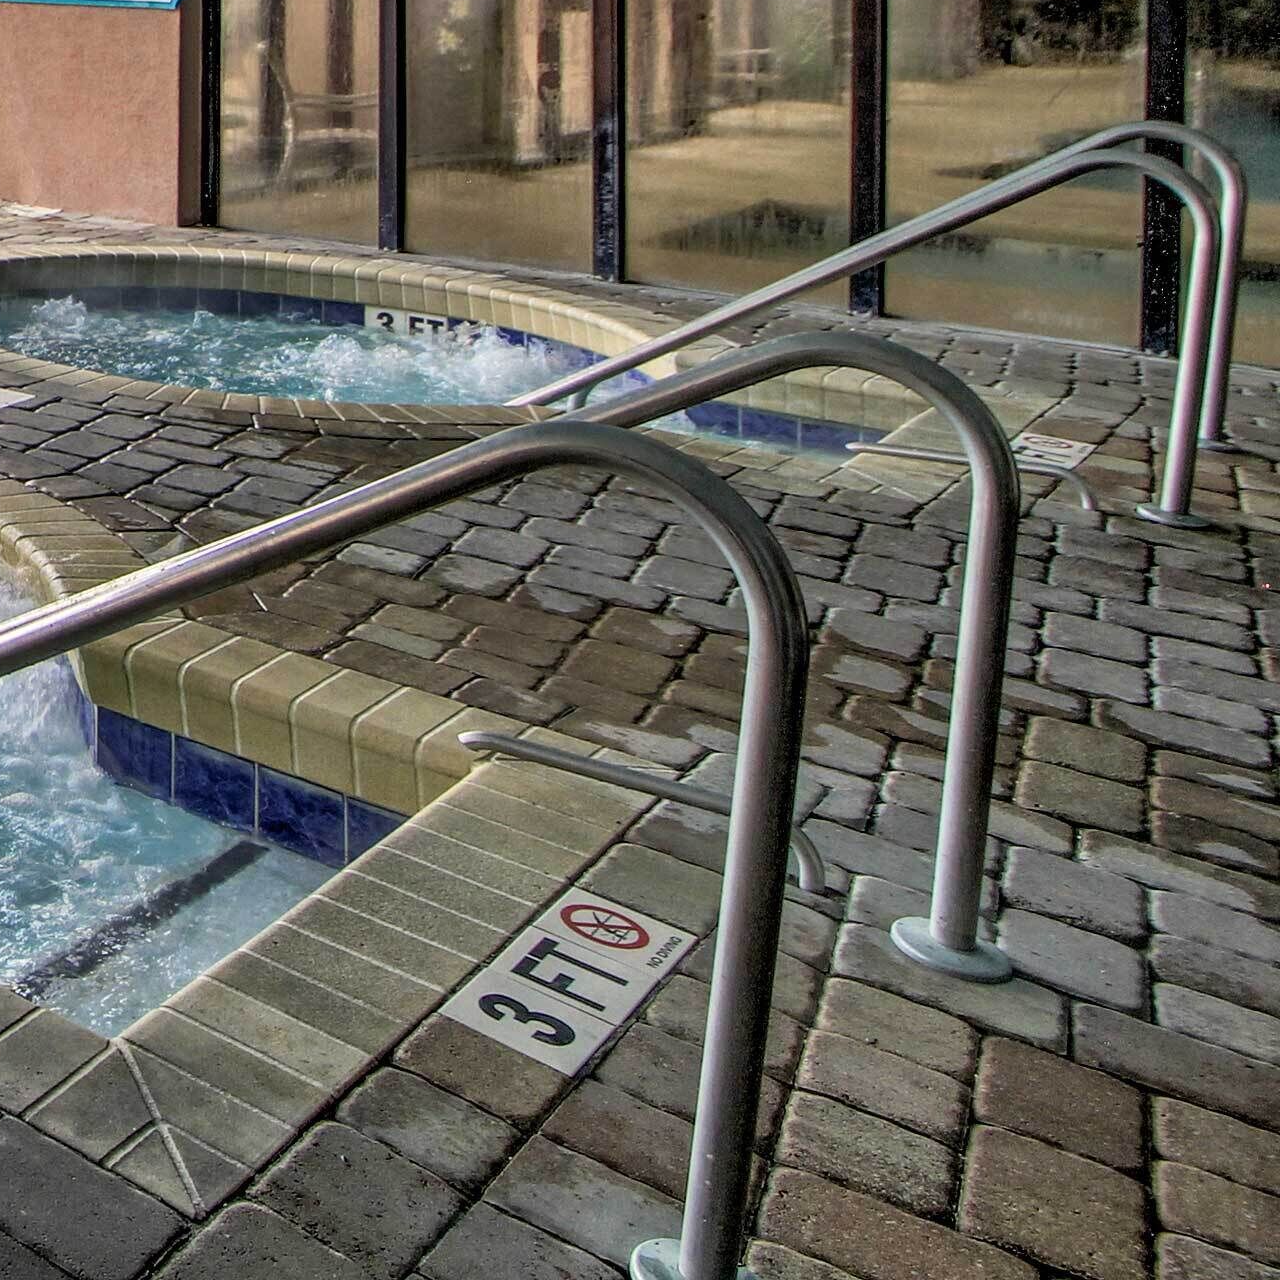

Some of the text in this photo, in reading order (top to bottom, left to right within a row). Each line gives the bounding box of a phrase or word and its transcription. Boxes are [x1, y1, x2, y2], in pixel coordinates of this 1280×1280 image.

[409, 315, 444, 336] FT
[646, 936, 682, 969] NO DIVING
[478, 937, 629, 1046] 3 FT
